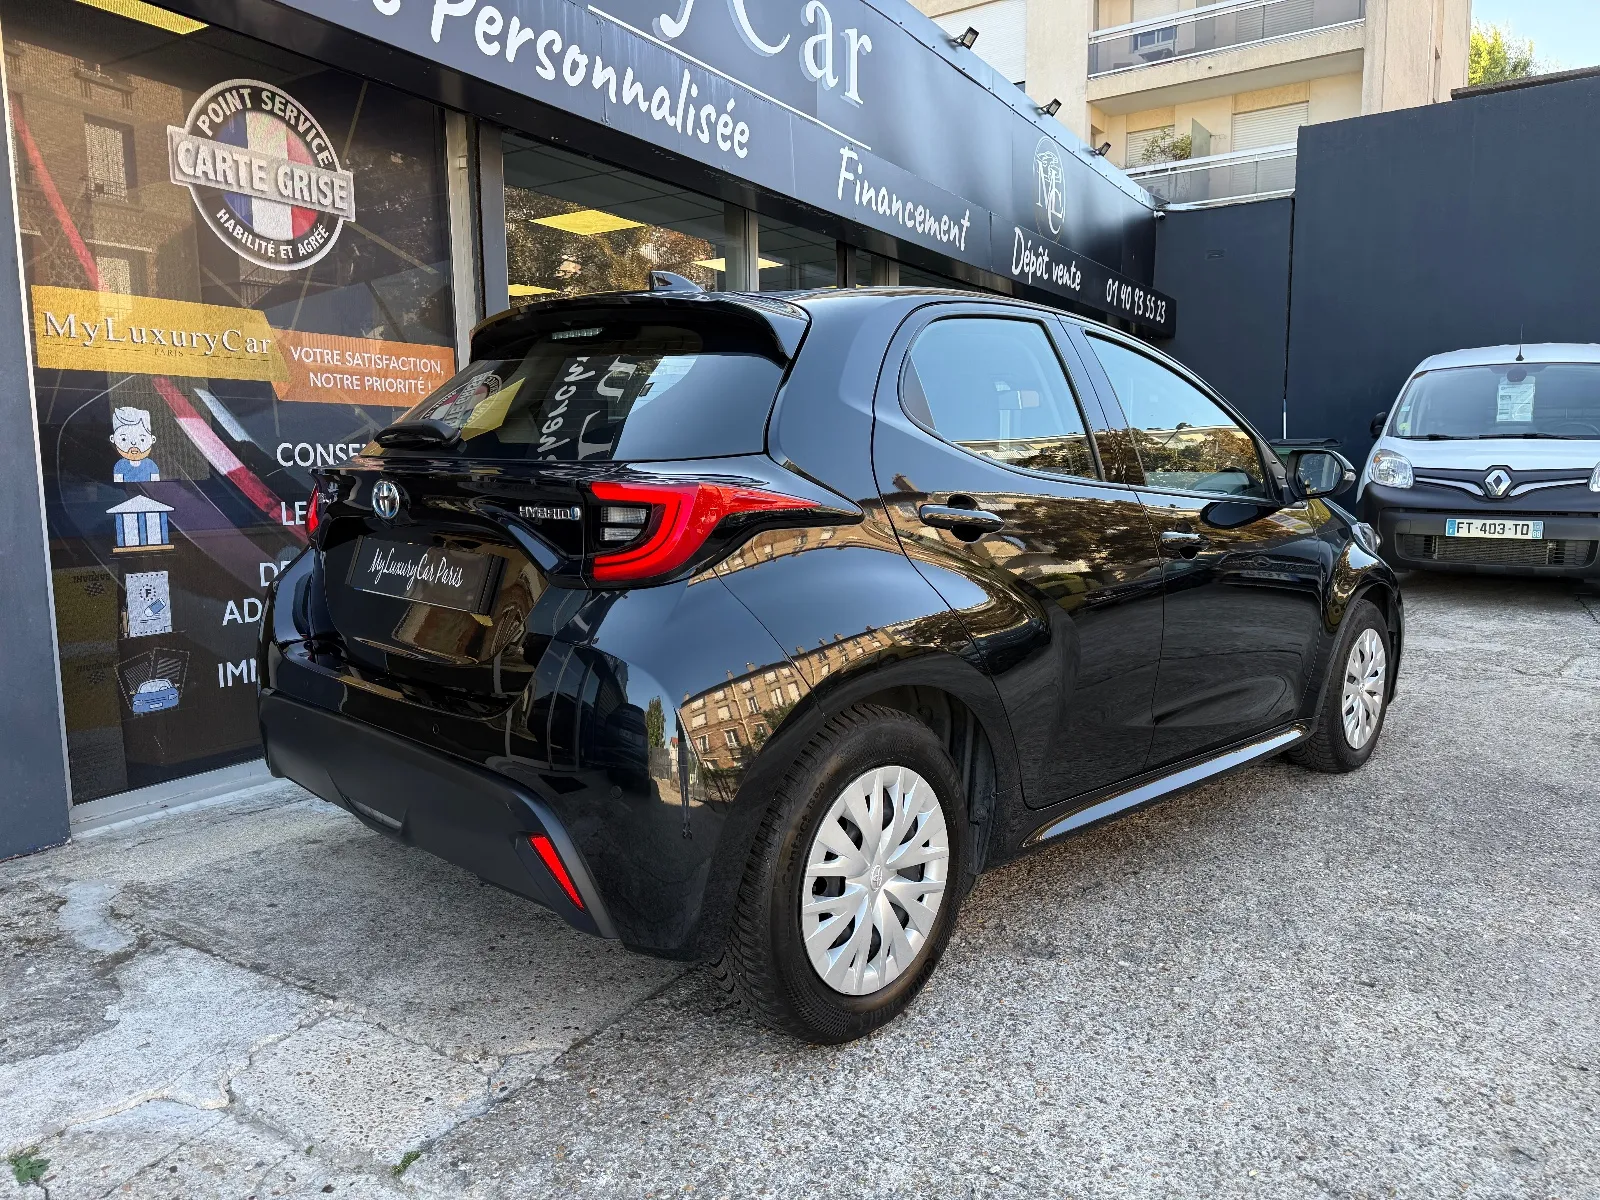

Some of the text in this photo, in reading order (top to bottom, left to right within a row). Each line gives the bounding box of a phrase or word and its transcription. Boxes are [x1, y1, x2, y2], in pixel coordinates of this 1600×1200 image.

[430, 0, 749, 159] Personnalisée
[196, 88, 333, 167] POINT SERVICE
[177, 140, 348, 210] CARTE GRISE
[837, 146, 970, 252] Financement
[216, 207, 330, 259] HABILITÉ ET AGRÉÉ
[1011, 226, 1082, 292] Dépôt vente
[1106, 278, 1166, 324] 01 40 93 55 23
[43, 311, 272, 356] MyLuxuryCar
[154, 348, 184, 358] PARIS
[290, 346, 444, 376] VOTRE SATISFACTION,
[309, 371, 361, 390] NOTRE
[364, 376, 425, 395] PRIORITÉ
[276, 442, 367, 468] CONSE
[519, 505, 571, 520] HYBRID
